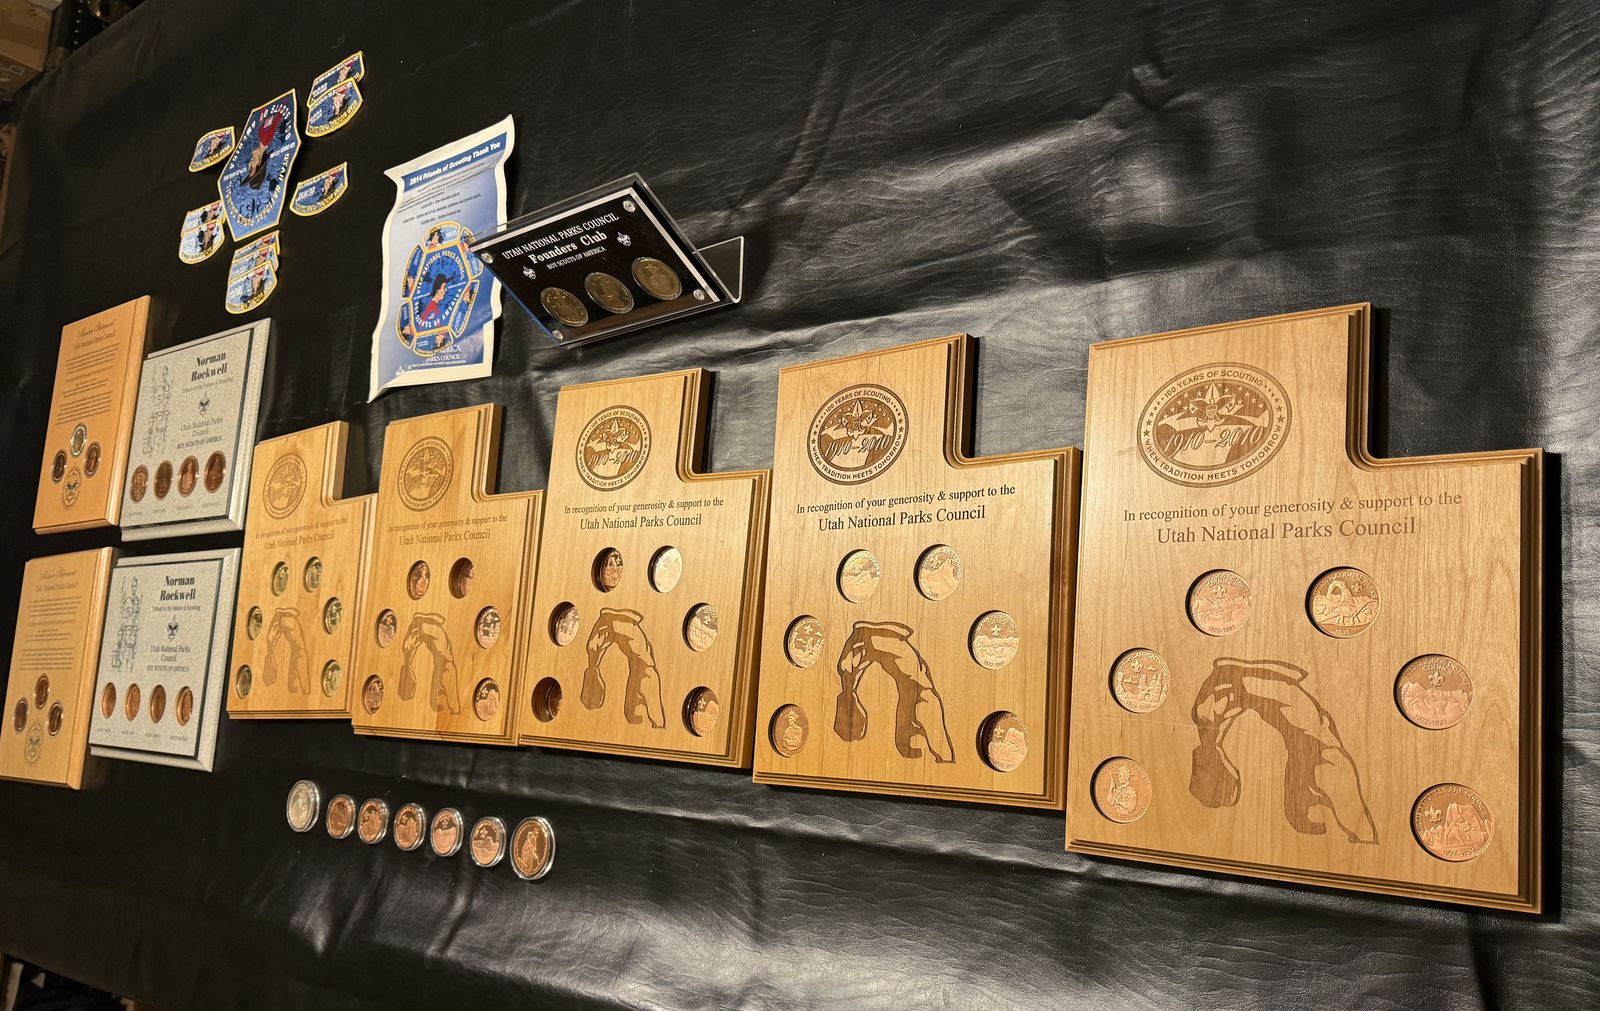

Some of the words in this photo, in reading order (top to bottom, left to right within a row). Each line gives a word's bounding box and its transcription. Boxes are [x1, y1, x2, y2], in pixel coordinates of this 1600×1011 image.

[410, 174, 422, 185] 2014
[423, 168, 441, 180] Friends
[443, 163, 448, 171] of
[449, 155, 471, 170] Scouting
[473, 147, 489, 159] Thank
[490, 142, 500, 150] You
[502, 248, 524, 260] UTAH
[522, 234, 560, 252] NATIONAL
[558, 225, 584, 239] PARKS
[582, 213, 619, 231] COUNCIL
[528, 242, 578, 264] Founders
[580, 231, 607, 245] Club
[558, 257, 577, 267] SCOUTS
[583, 246, 606, 258] AMERICA
[191, 363, 227, 382] Rockwell
[196, 352, 226, 367] Norman
[1164, 387, 1176, 398] 100
[1178, 373, 1204, 389] YEARS
[1221, 370, 1263, 386] SCOUTING
[835, 393, 852, 405] YEARS
[863, 390, 890, 403] SCOUTING
[812, 446, 822, 464] WHEN
[822, 465, 850, 479] TRADITION
[853, 470, 872, 479] MEETS
[874, 434, 902, 471] TOMORROW
[1145, 438, 1159, 463] WHEN
[1159, 461, 1204, 480] TRADITION
[1207, 468, 1238, 481] MEETS
[1240, 425, 1282, 471] TOMORROW
[564, 506, 570, 514] In
[572, 504, 607, 515] recognition
[609, 503, 616, 512] of
[616, 504, 631, 513] your
[633, 500, 666, 512] generosity
[668, 500, 675, 509] &
[677, 499, 703, 511] support
[713, 497, 723, 505] the
[797, 504, 804, 514] In
[807, 500, 853, 514] recognition
[856, 499, 866, 508] of
[867, 500, 886, 510] your
[889, 492, 934, 508] generosity
[938, 490, 946, 501] &
[949, 488, 984, 503] support
[988, 488, 997, 496] to
[1000, 484, 1015, 495] the
[1124, 510, 1135, 521] In
[1140, 506, 1208, 522] recognition
[1212, 504, 1227, 516] of
[1229, 505, 1260, 518] your
[1264, 498, 1335, 517] generosity
[1340, 497, 1353, 509] &
[1359, 495, 1414, 511] support
[1418, 495, 1433, 506] to
[1439, 492, 1462, 505] the
[580, 518, 599, 530] Utah
[602, 516, 637, 529] National
[640, 516, 663, 527] Parks
[667, 514, 701, 526] Council
[819, 517, 844, 531] Utah
[848, 513, 896, 529] National
[900, 510, 932, 525] Parks
[936, 505, 985, 522] Council
[1157, 527, 1196, 543] Utah
[1201, 523, 1275, 541] National
[1281, 521, 1332, 538] Parks
[1339, 517, 1416, 537] Council
[160, 589, 196, 600] Rockwell
[163, 576, 195, 587] Norman
[1422, 664, 1453, 675] COUNCIL
